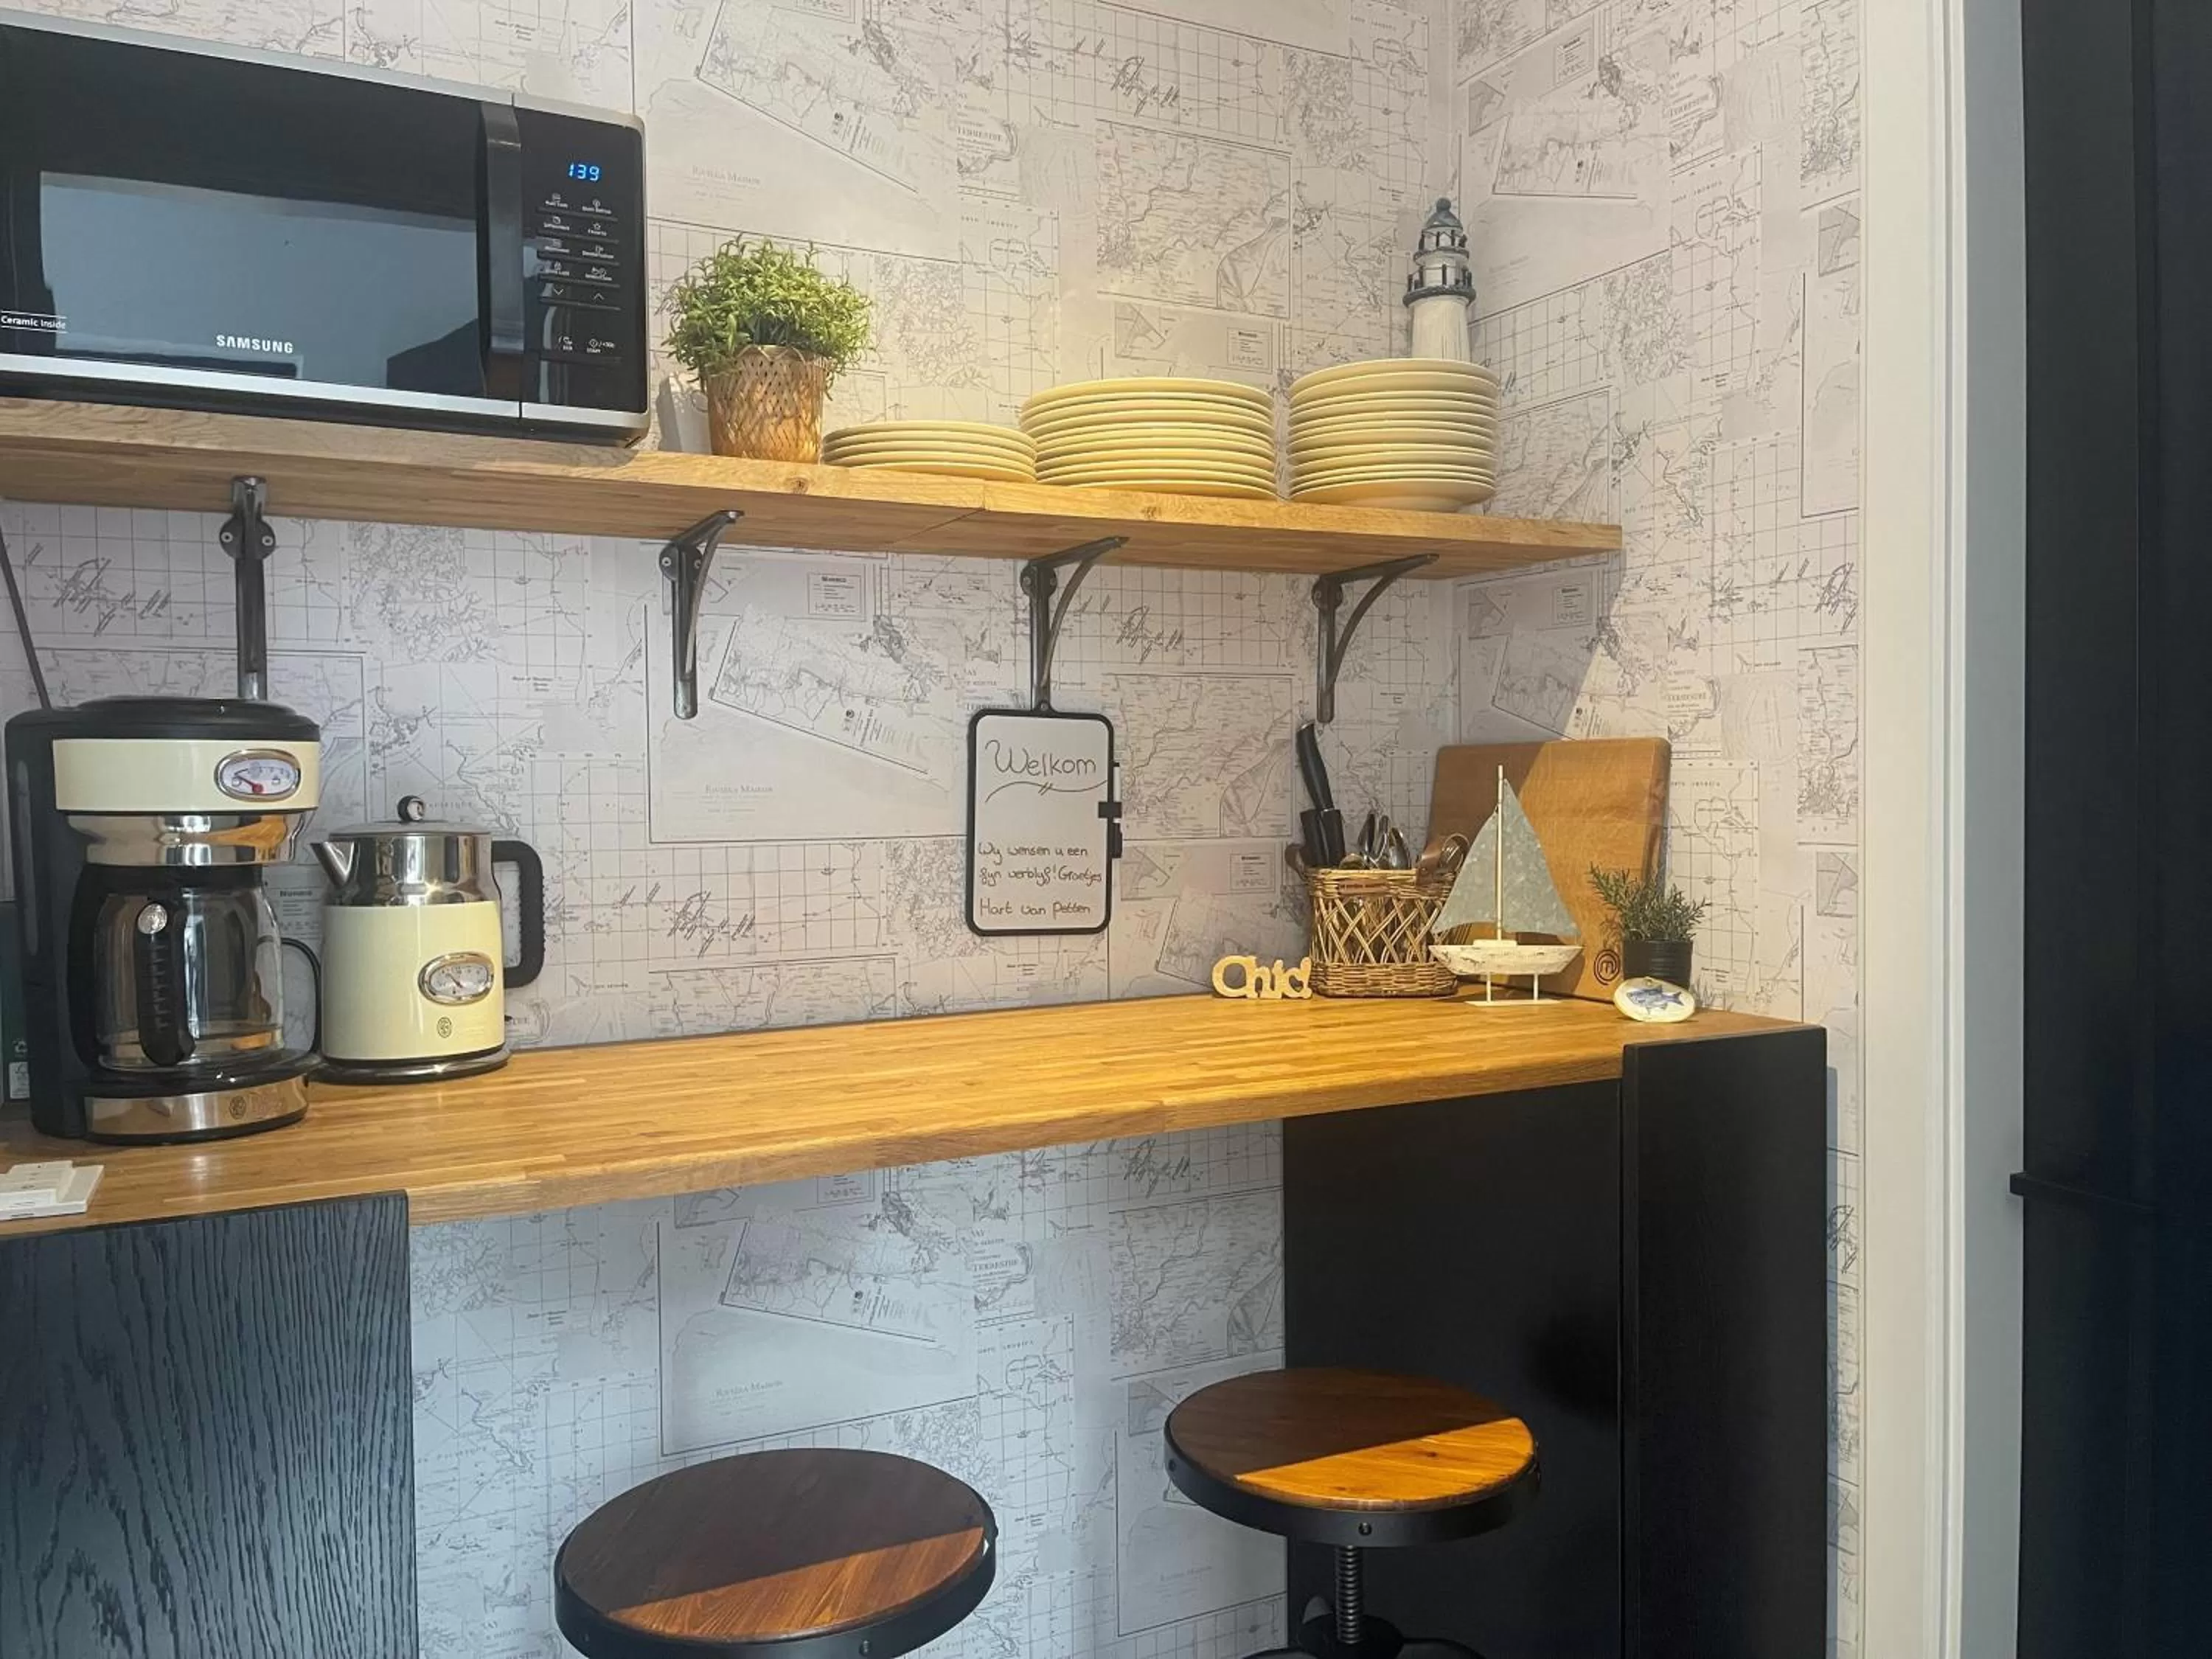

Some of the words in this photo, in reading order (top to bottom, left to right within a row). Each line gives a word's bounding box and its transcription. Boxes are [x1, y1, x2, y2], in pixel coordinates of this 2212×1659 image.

[1, 316, 39, 327] Ceramic
[41, 319, 66, 330] Inside
[216, 334, 293, 354] SAMSUNG
[984, 739, 1096, 776] Welkom
[1007, 846, 1051, 856] wensen
[1055, 847, 1064, 856] u
[1068, 847, 1088, 856] een
[979, 897, 1013, 917] Hart
[1020, 904, 1047, 915] van
